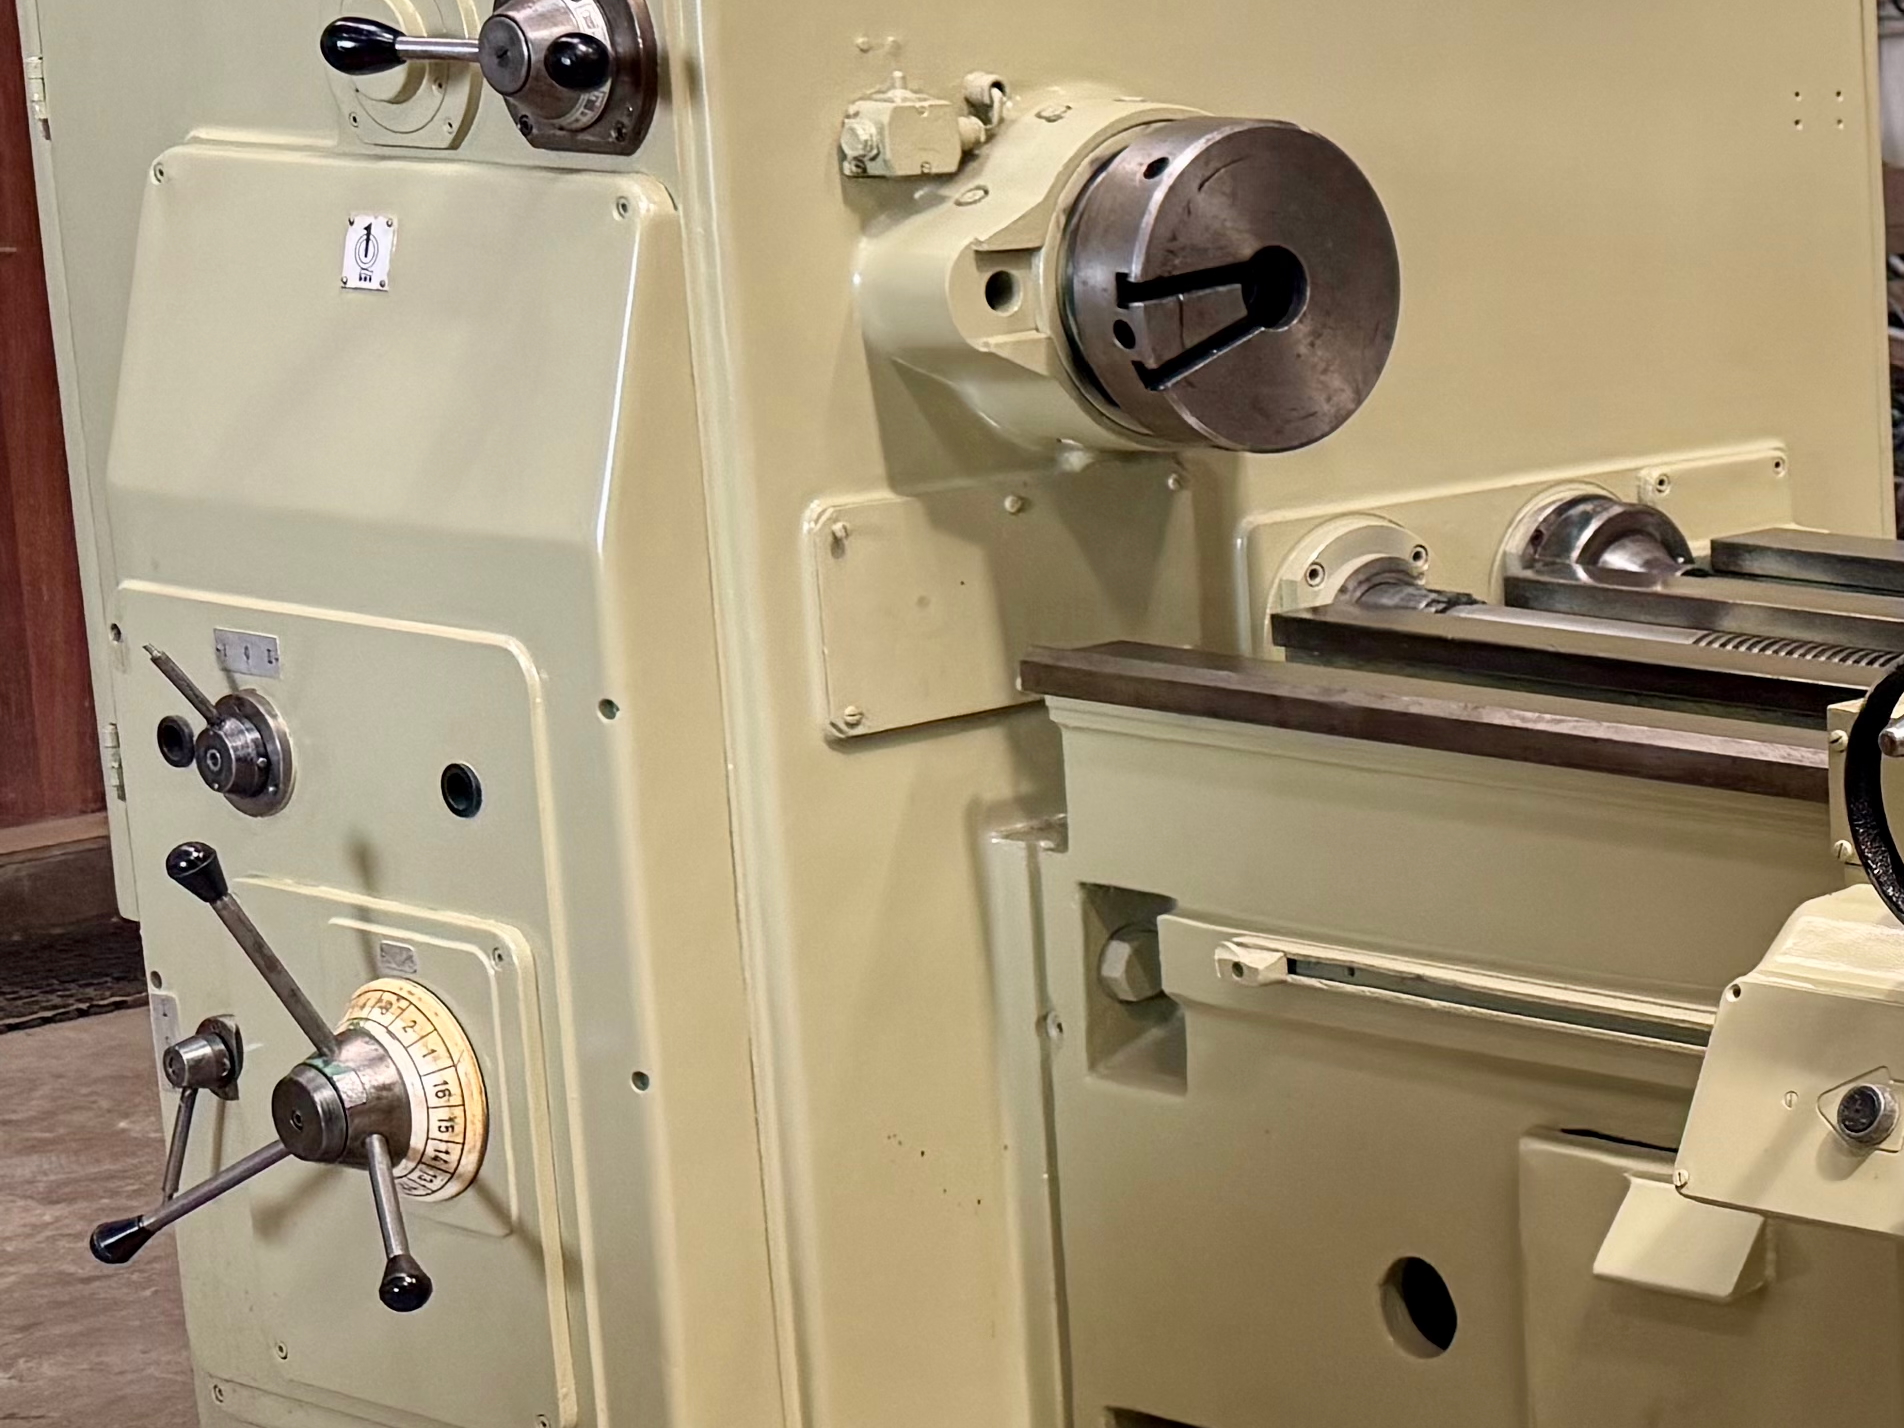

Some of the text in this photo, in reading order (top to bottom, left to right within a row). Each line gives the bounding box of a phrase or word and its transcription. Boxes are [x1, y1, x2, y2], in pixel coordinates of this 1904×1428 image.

[401, 1018, 418, 1034] 2
[421, 1047, 438, 1059] 1
[432, 1078, 452, 1100] 16
[436, 1115, 455, 1134] 15
[432, 1144, 450, 1165] 14
